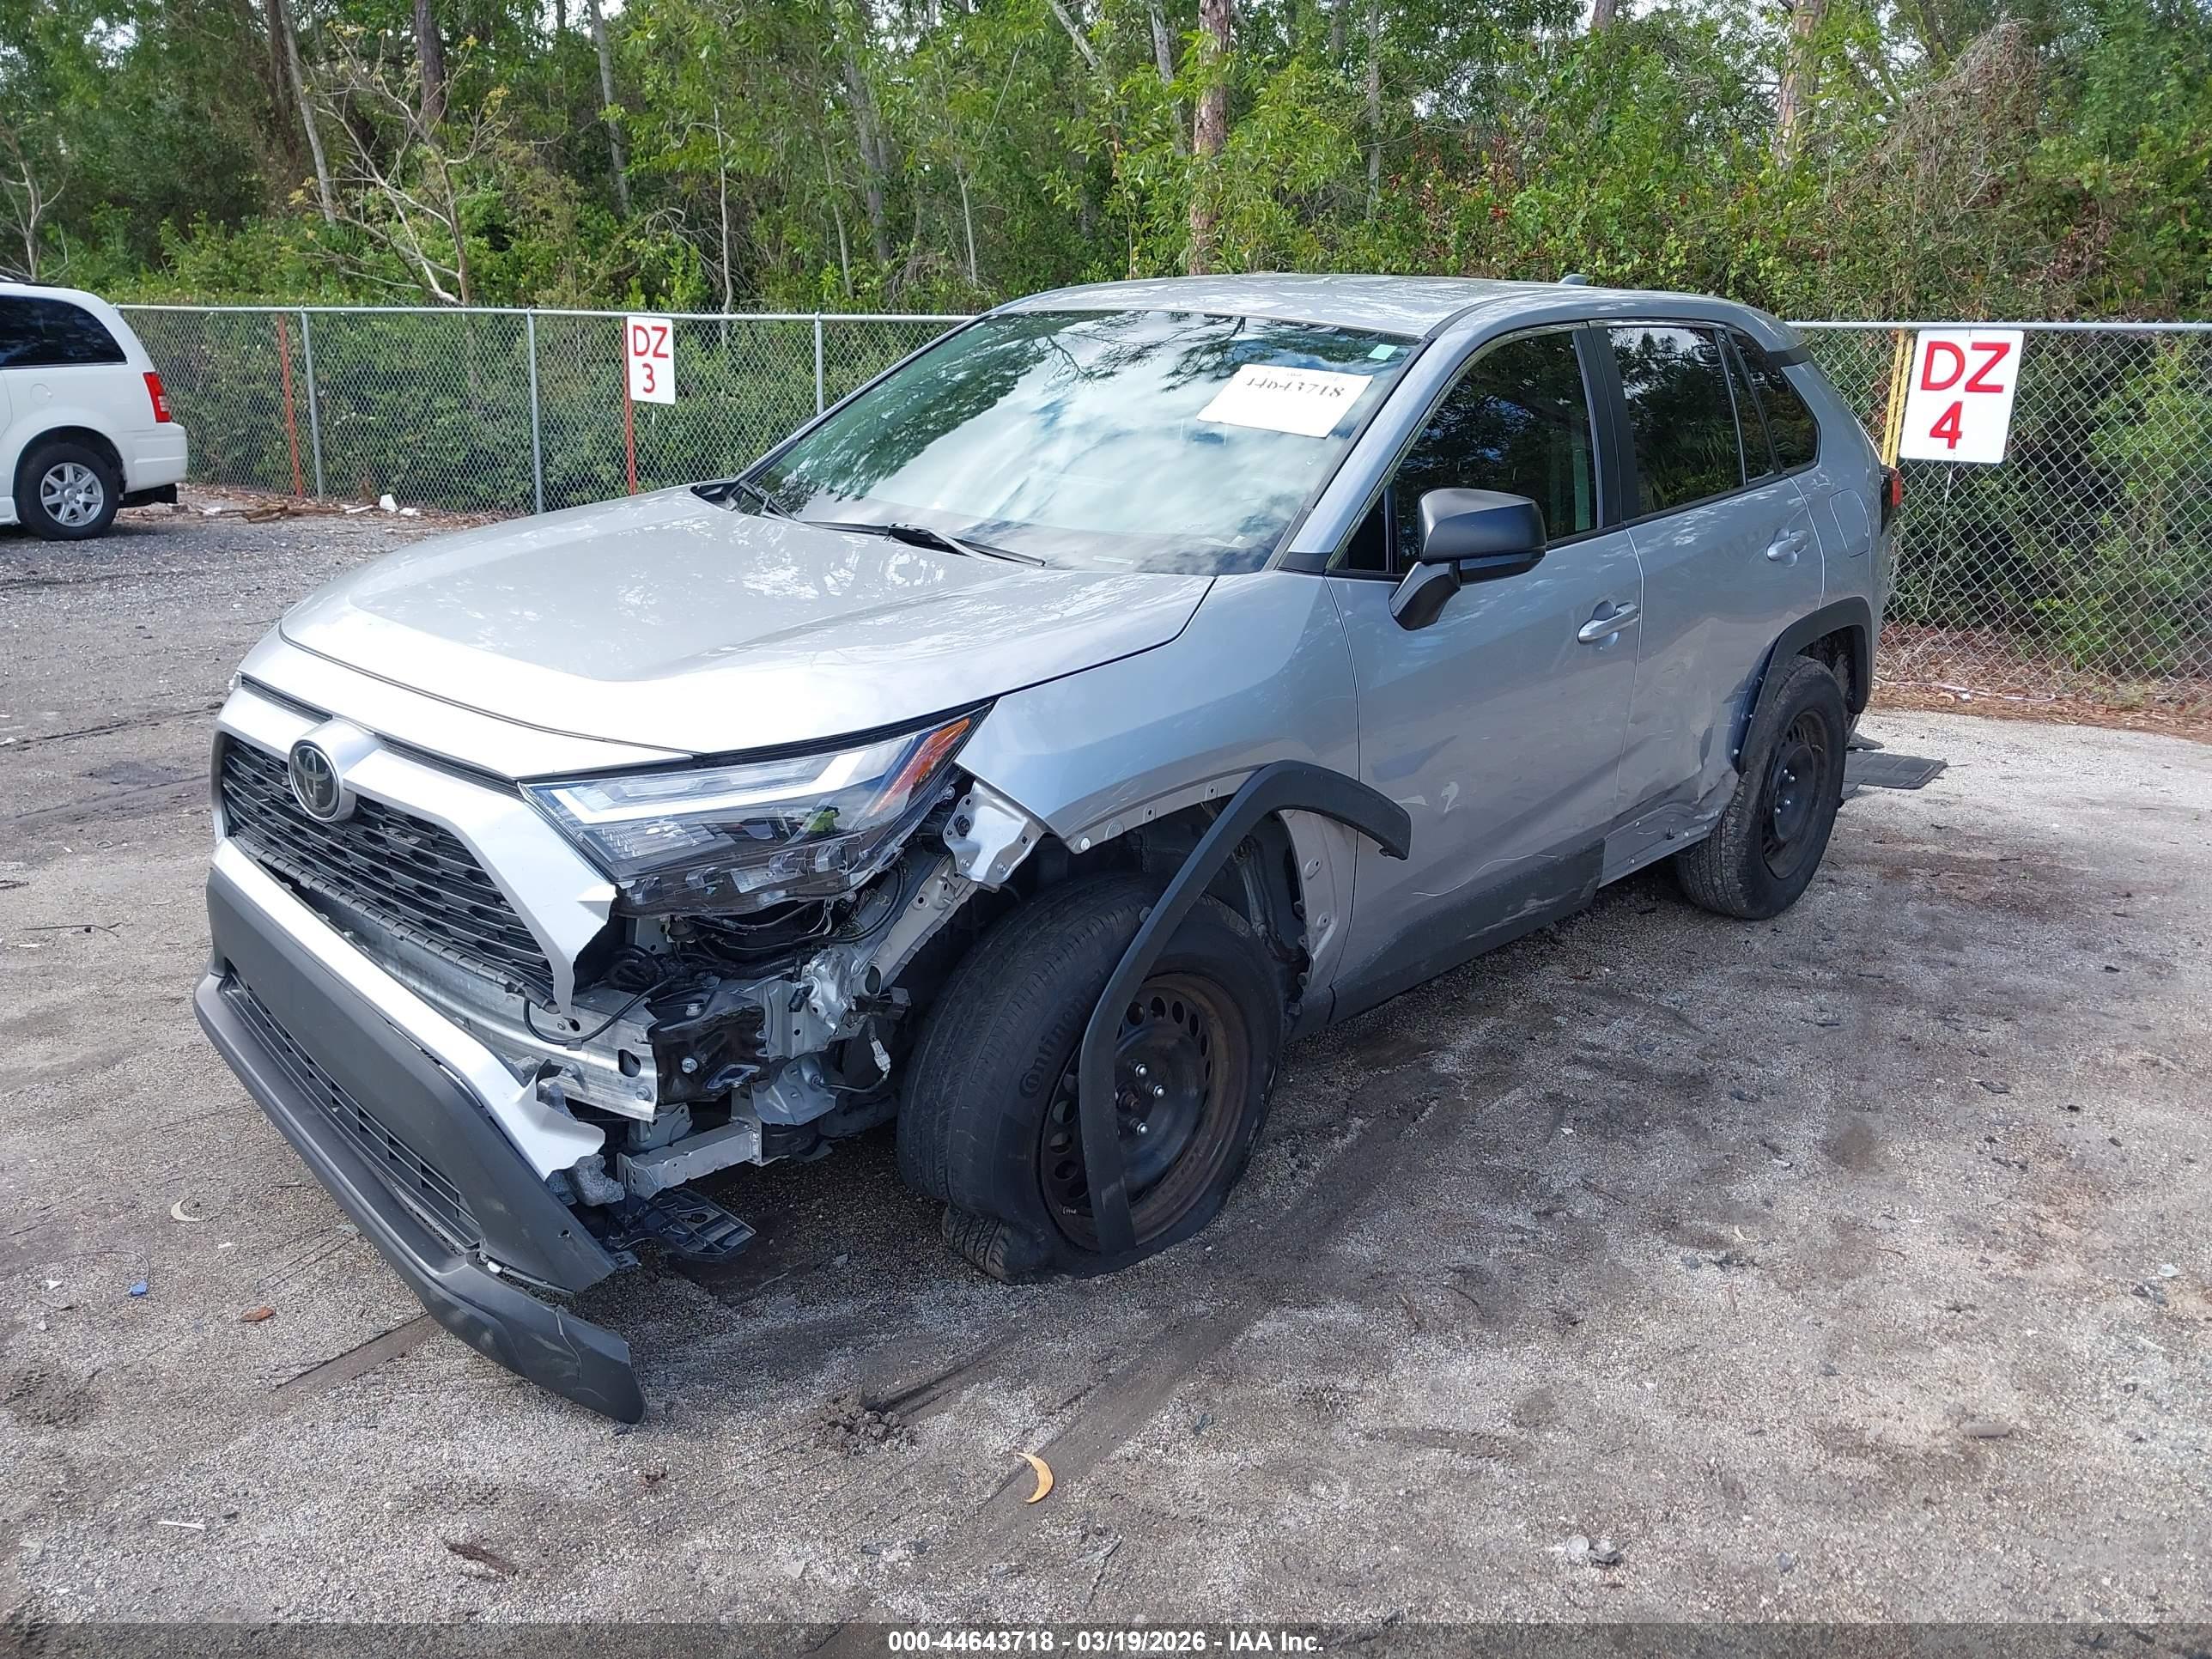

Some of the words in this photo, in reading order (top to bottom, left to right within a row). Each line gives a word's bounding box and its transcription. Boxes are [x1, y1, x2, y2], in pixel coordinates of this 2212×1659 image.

[633, 325, 669, 358] DZ
[642, 362, 655, 393] 3
[1921, 341, 2011, 393] DZ
[1929, 400, 1963, 449] 4
